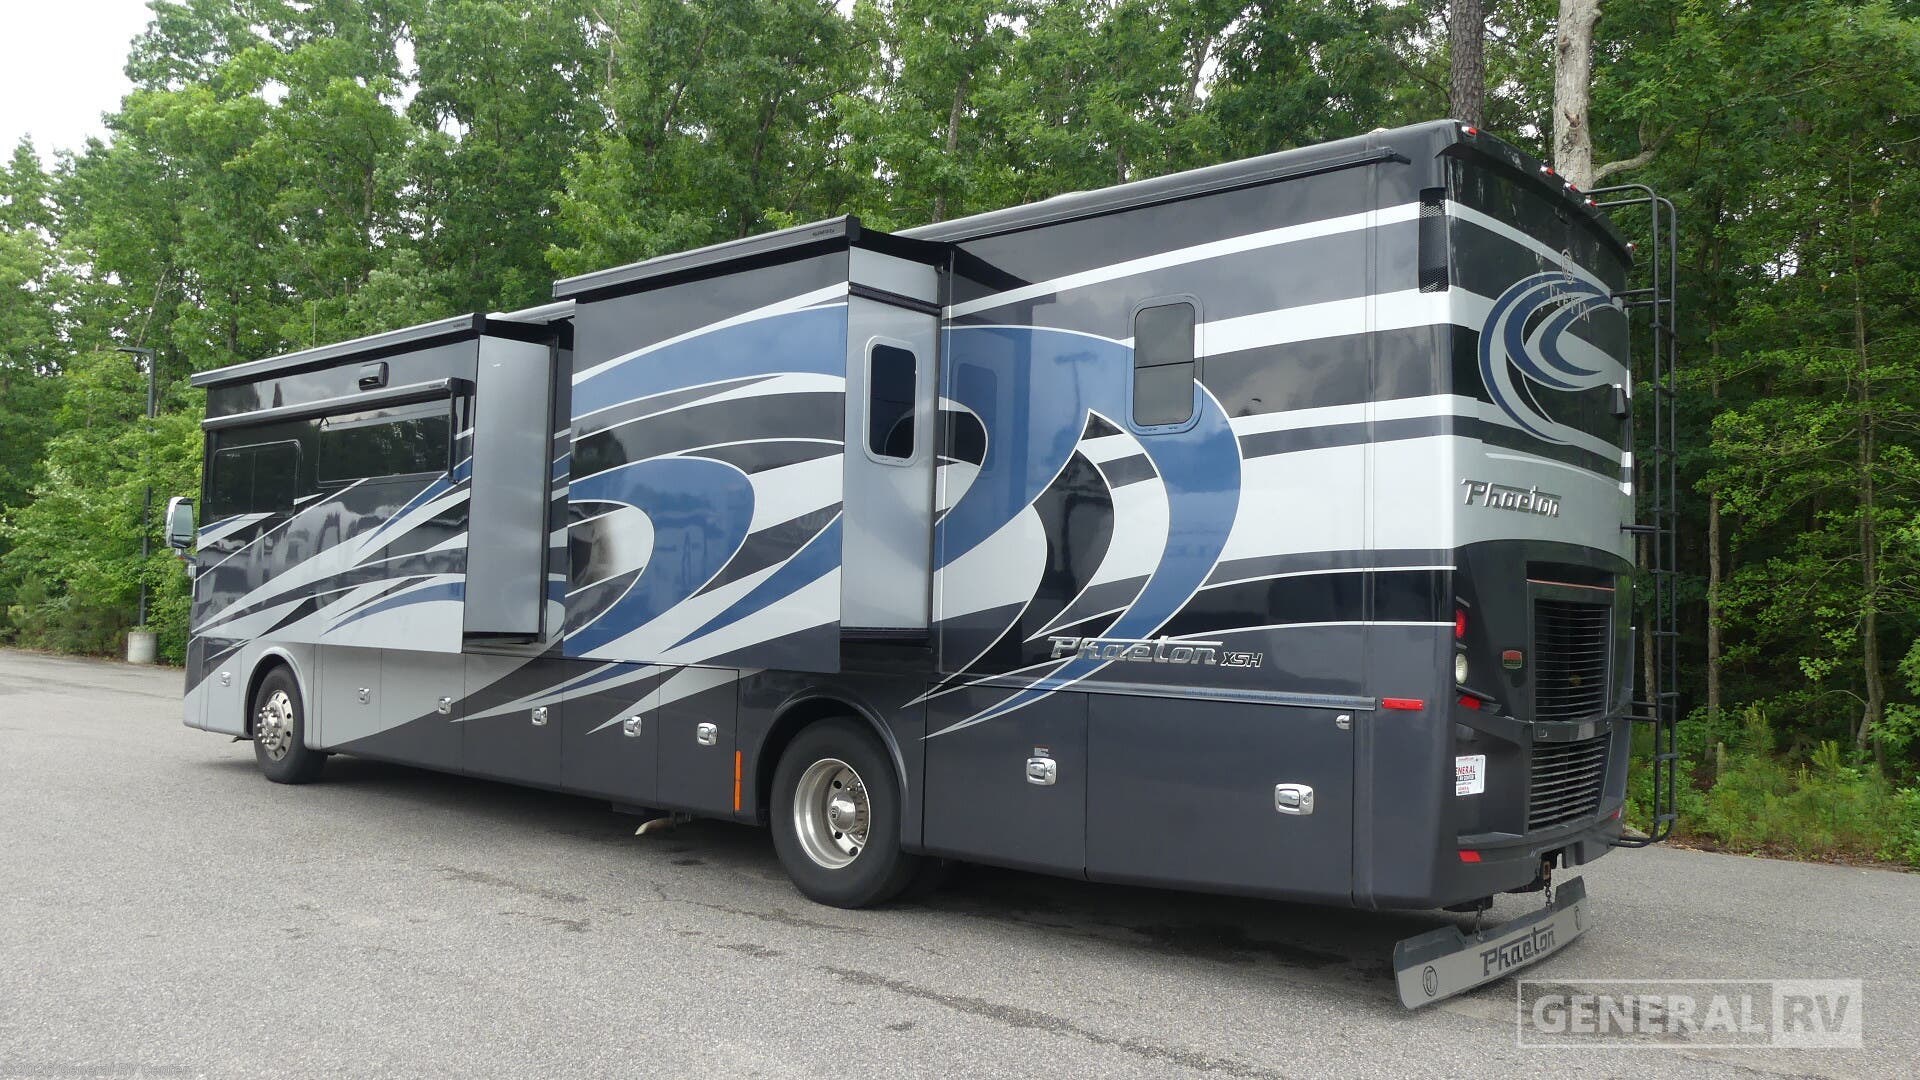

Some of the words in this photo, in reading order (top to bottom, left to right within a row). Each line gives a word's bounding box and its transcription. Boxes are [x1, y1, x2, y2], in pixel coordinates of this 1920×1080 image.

[1461, 478, 1562, 517] Phaeton
[1048, 635, 1223, 665] Phaeton
[1221, 651, 1263, 668] XSH
[1456, 765, 1475, 776] ENERAL
[1480, 923, 1554, 976] Phaeton
